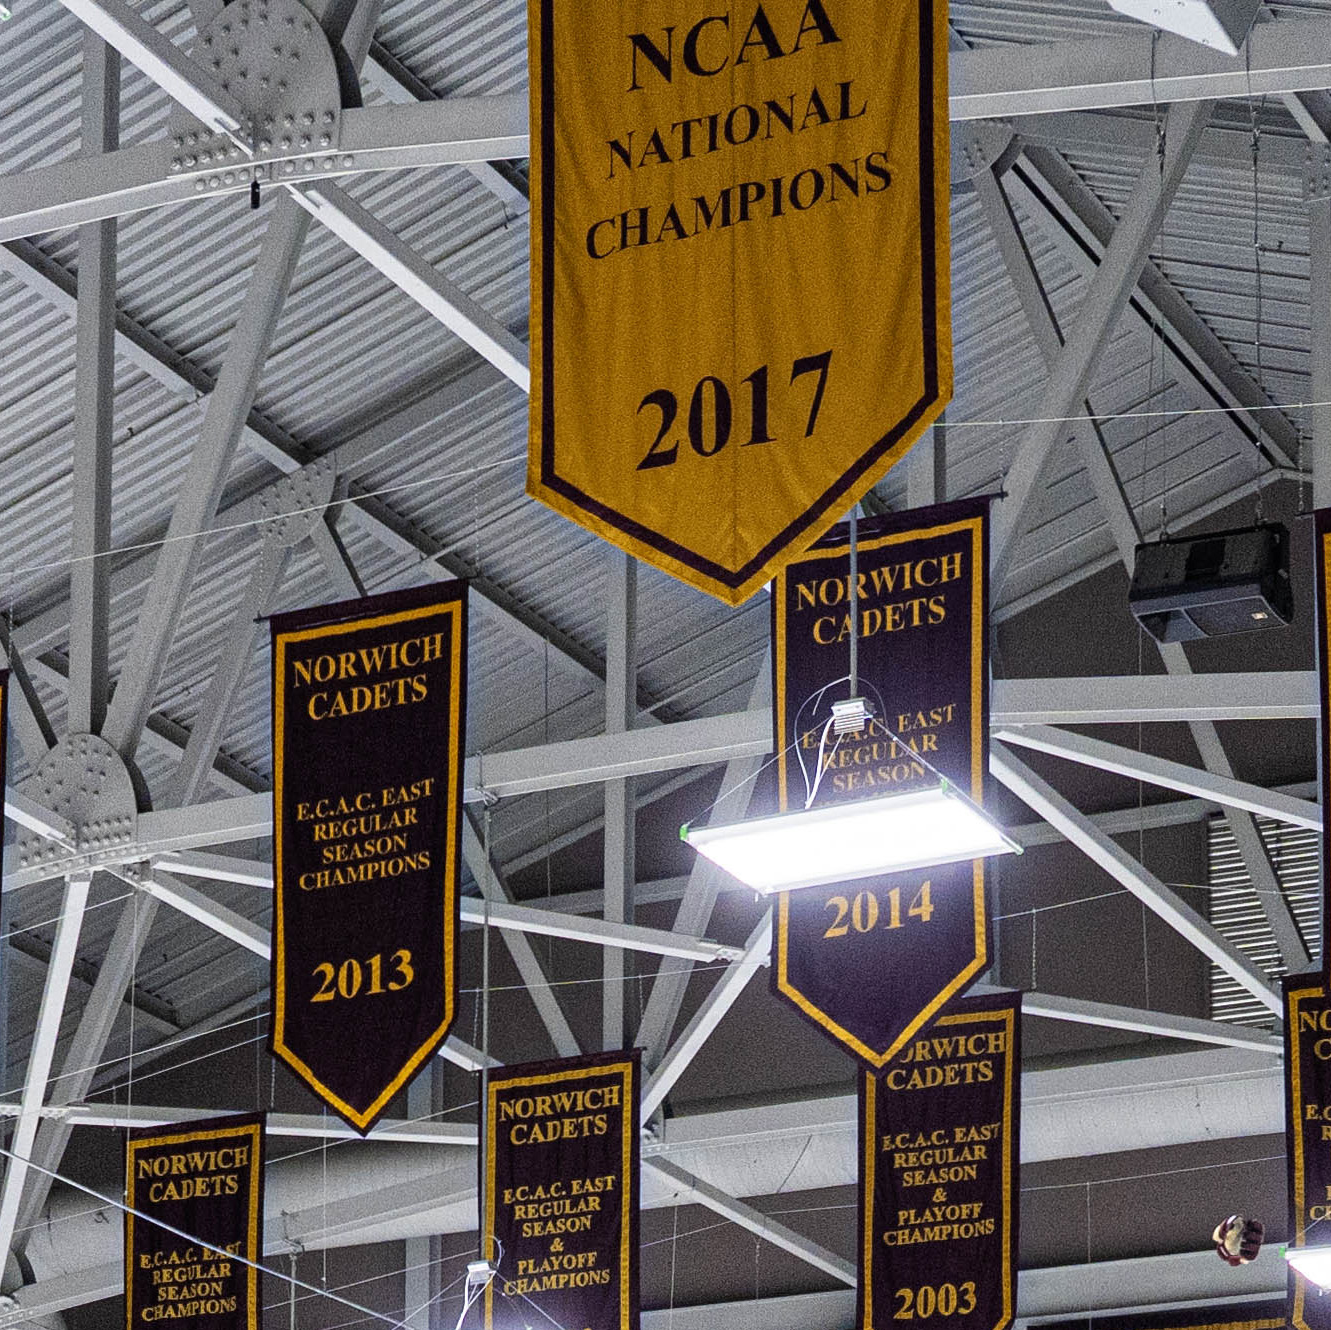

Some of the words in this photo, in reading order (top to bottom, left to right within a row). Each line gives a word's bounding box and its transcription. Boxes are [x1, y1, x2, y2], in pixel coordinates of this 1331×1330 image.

[627, 0, 842, 92] NCAA
[606, 80, 868, 179] NATIONAL
[587, 152, 891, 259] CHAMPIONS
[636, 350, 832, 470] 2017
[293, 632, 443, 688] NORWICH
[308, 674, 428, 721] CADETS
[296, 793, 375, 821] E.C.A.C.
[382, 778, 435, 806] EAST
[314, 805, 418, 842] REGULAR
[299, 851, 430, 891] CHAMPIONS
[322, 834, 407, 864] SEASON
[824, 880, 934, 939] 2014
[310, 949, 415, 1003] 2013
[886, 1061, 993, 1091] CADETS
[139, 1145, 249, 1179] NORWICH
[149, 1175, 238, 1203] CADETS
[894, 1282, 977, 1320] 2003
